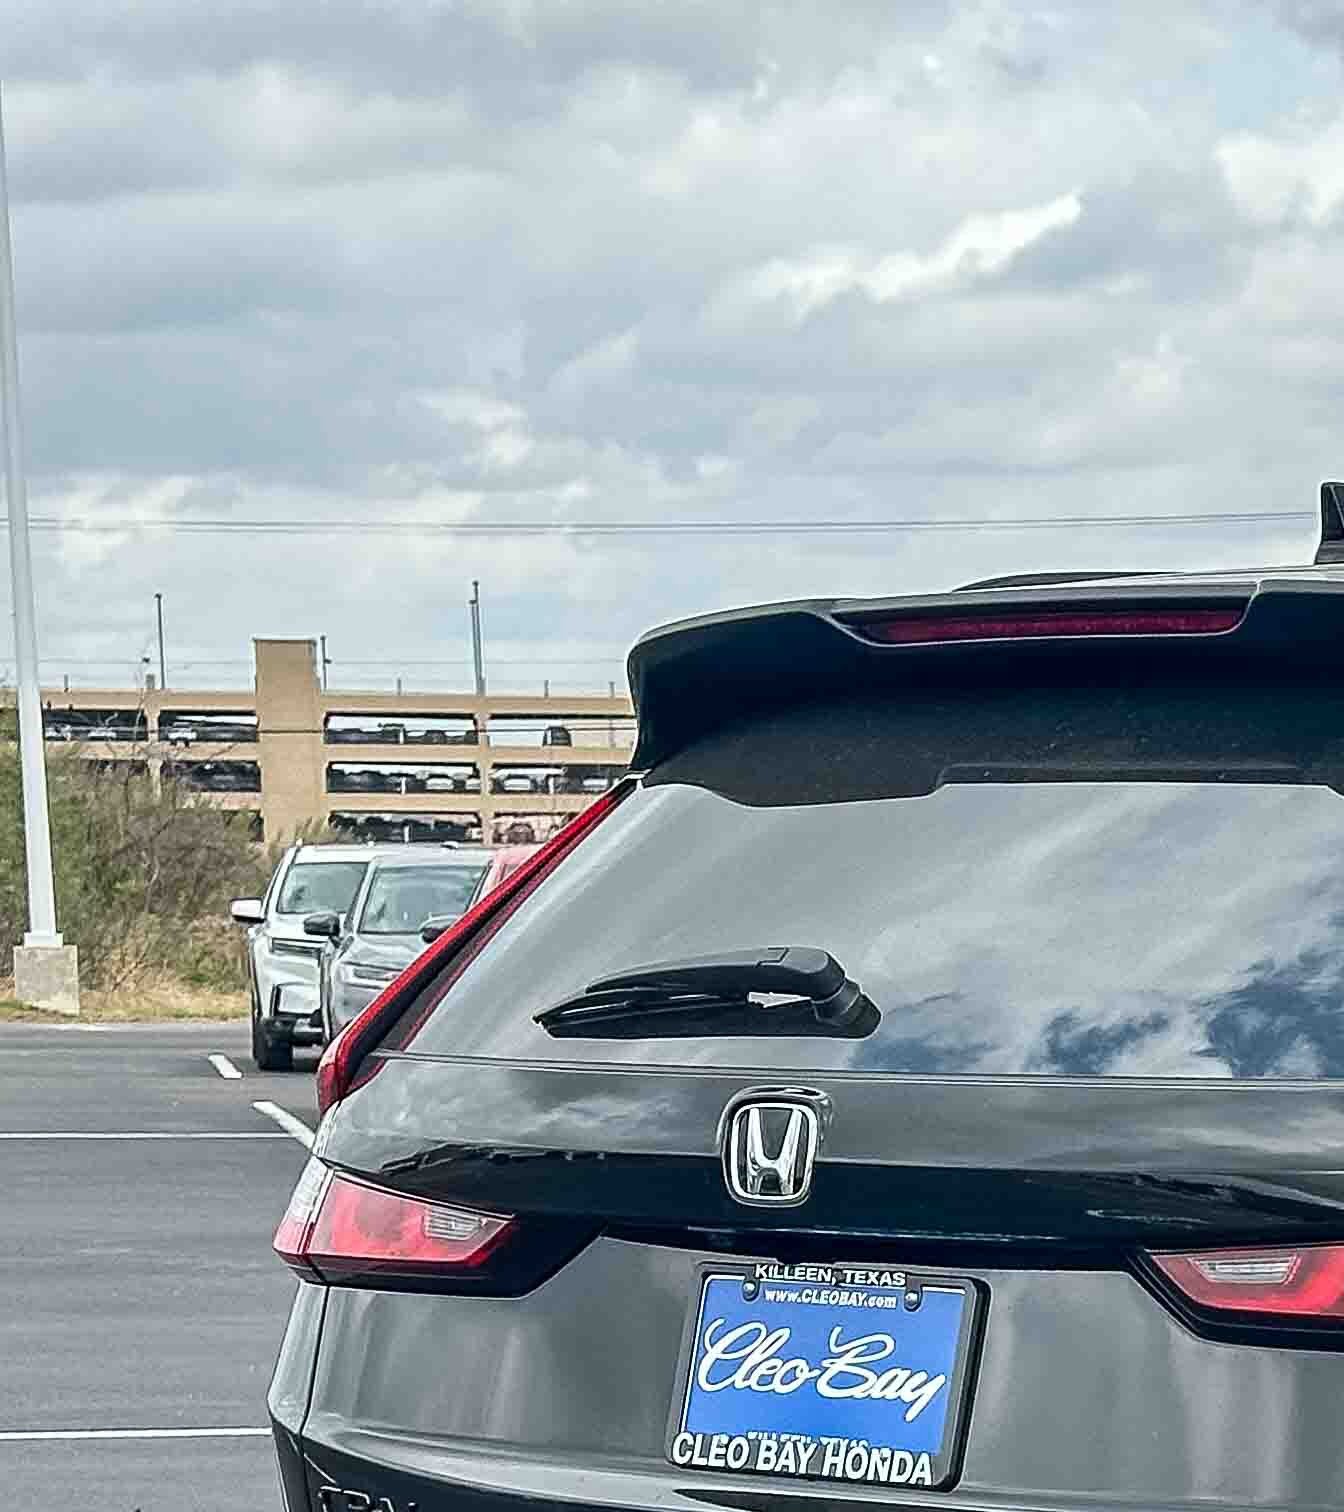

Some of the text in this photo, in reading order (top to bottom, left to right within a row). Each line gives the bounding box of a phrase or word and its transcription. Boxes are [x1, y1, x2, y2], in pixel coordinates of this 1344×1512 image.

[755, 1264, 906, 1287] KILLEEN, TEXAS
[696, 1317, 947, 1423] Cleo Bay
[672, 1431, 750, 1470] CLEO
[755, 1438, 819, 1475] BAY
[821, 1446, 934, 1487] HONDA
